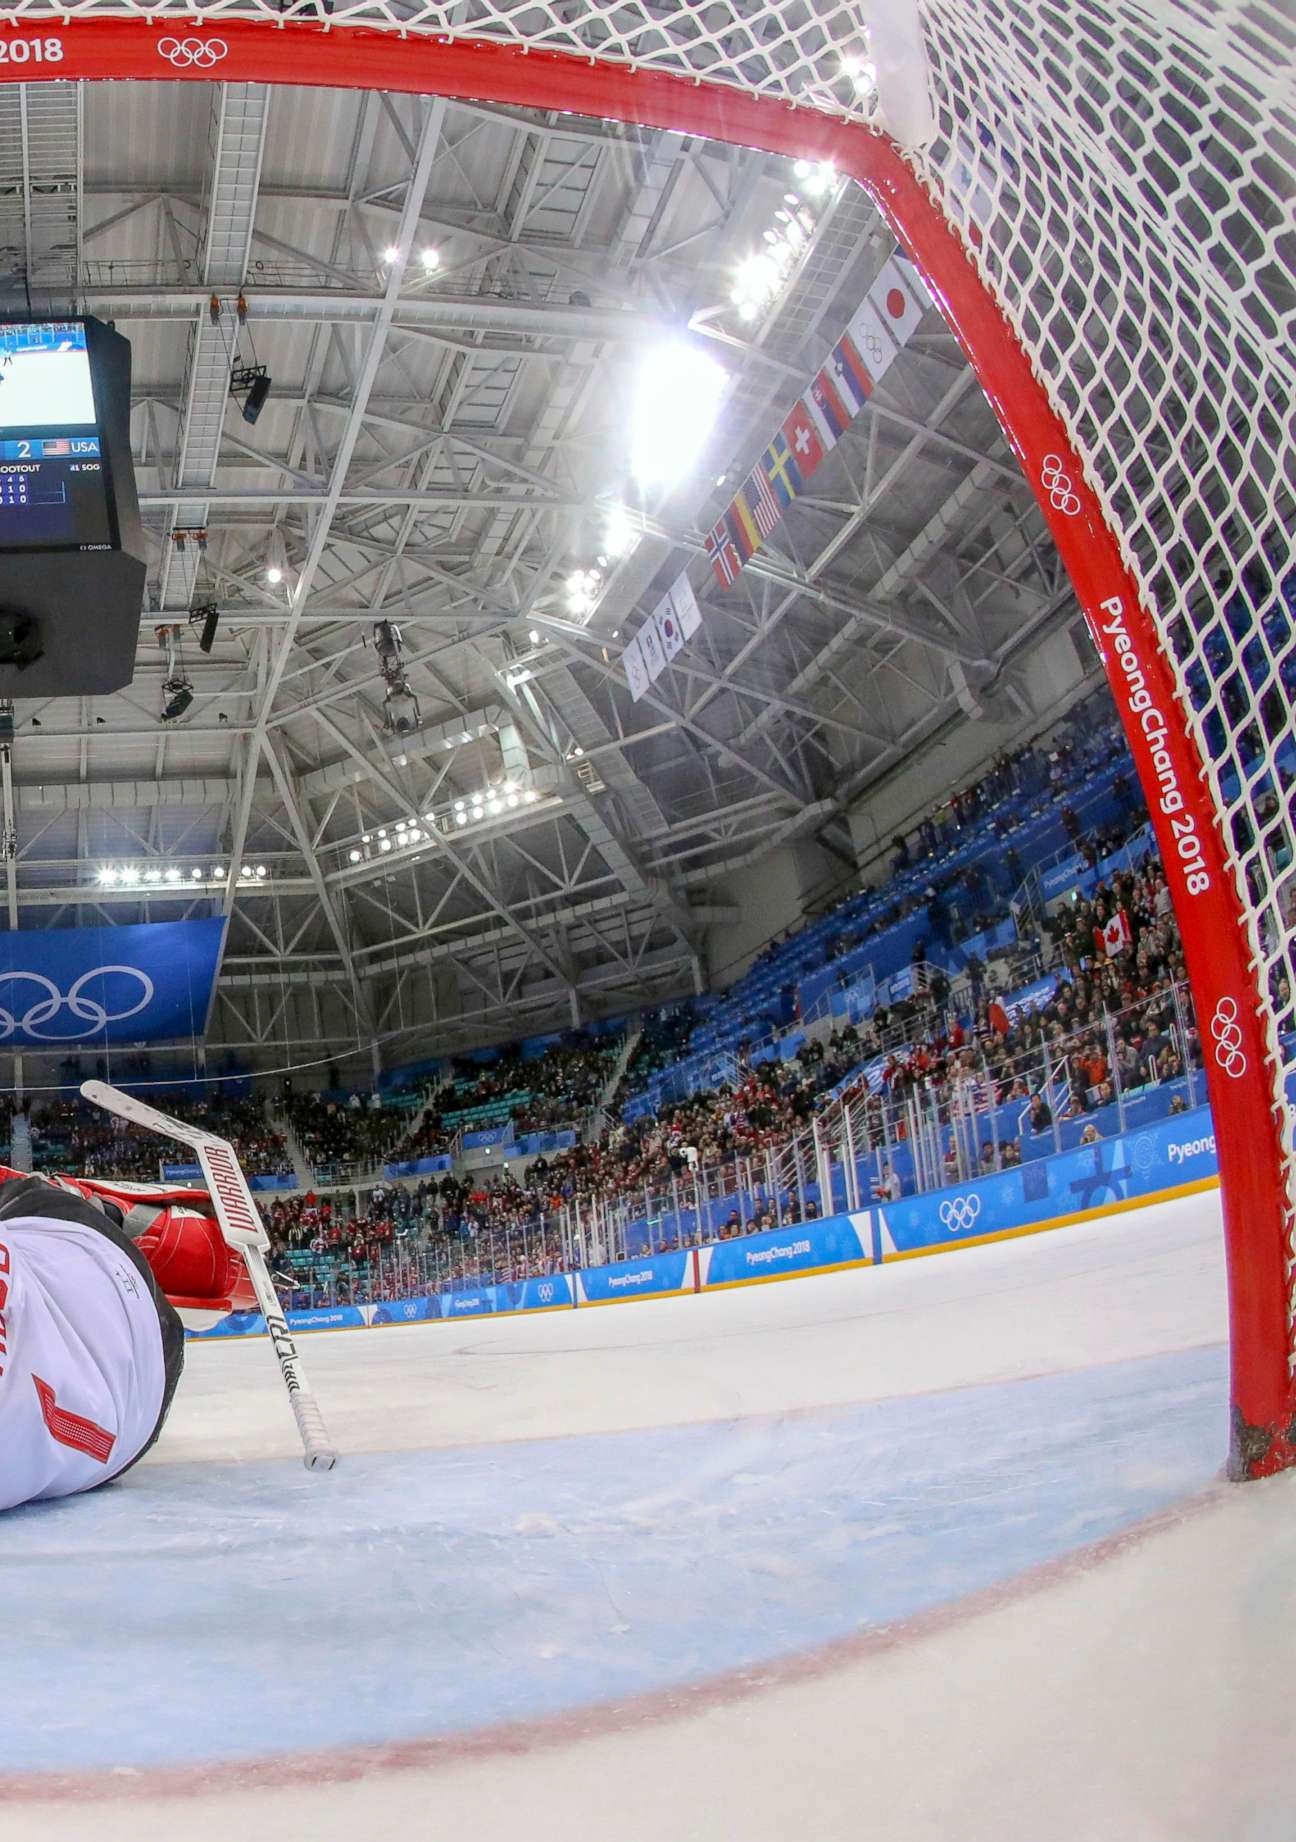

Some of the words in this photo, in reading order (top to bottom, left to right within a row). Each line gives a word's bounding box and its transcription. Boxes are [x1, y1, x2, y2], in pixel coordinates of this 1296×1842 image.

[16, 440, 32, 458] 2
[70, 441, 99, 453] USA
[81, 463, 101, 471] SOG
[1099, 596, 1184, 814] PyeongChang
[1170, 813, 1210, 896] 2018
[204, 1145, 259, 1233] WARRIOR
[746, 1246, 793, 1266] PyeongChang
[792, 1239, 811, 1255] 2018
